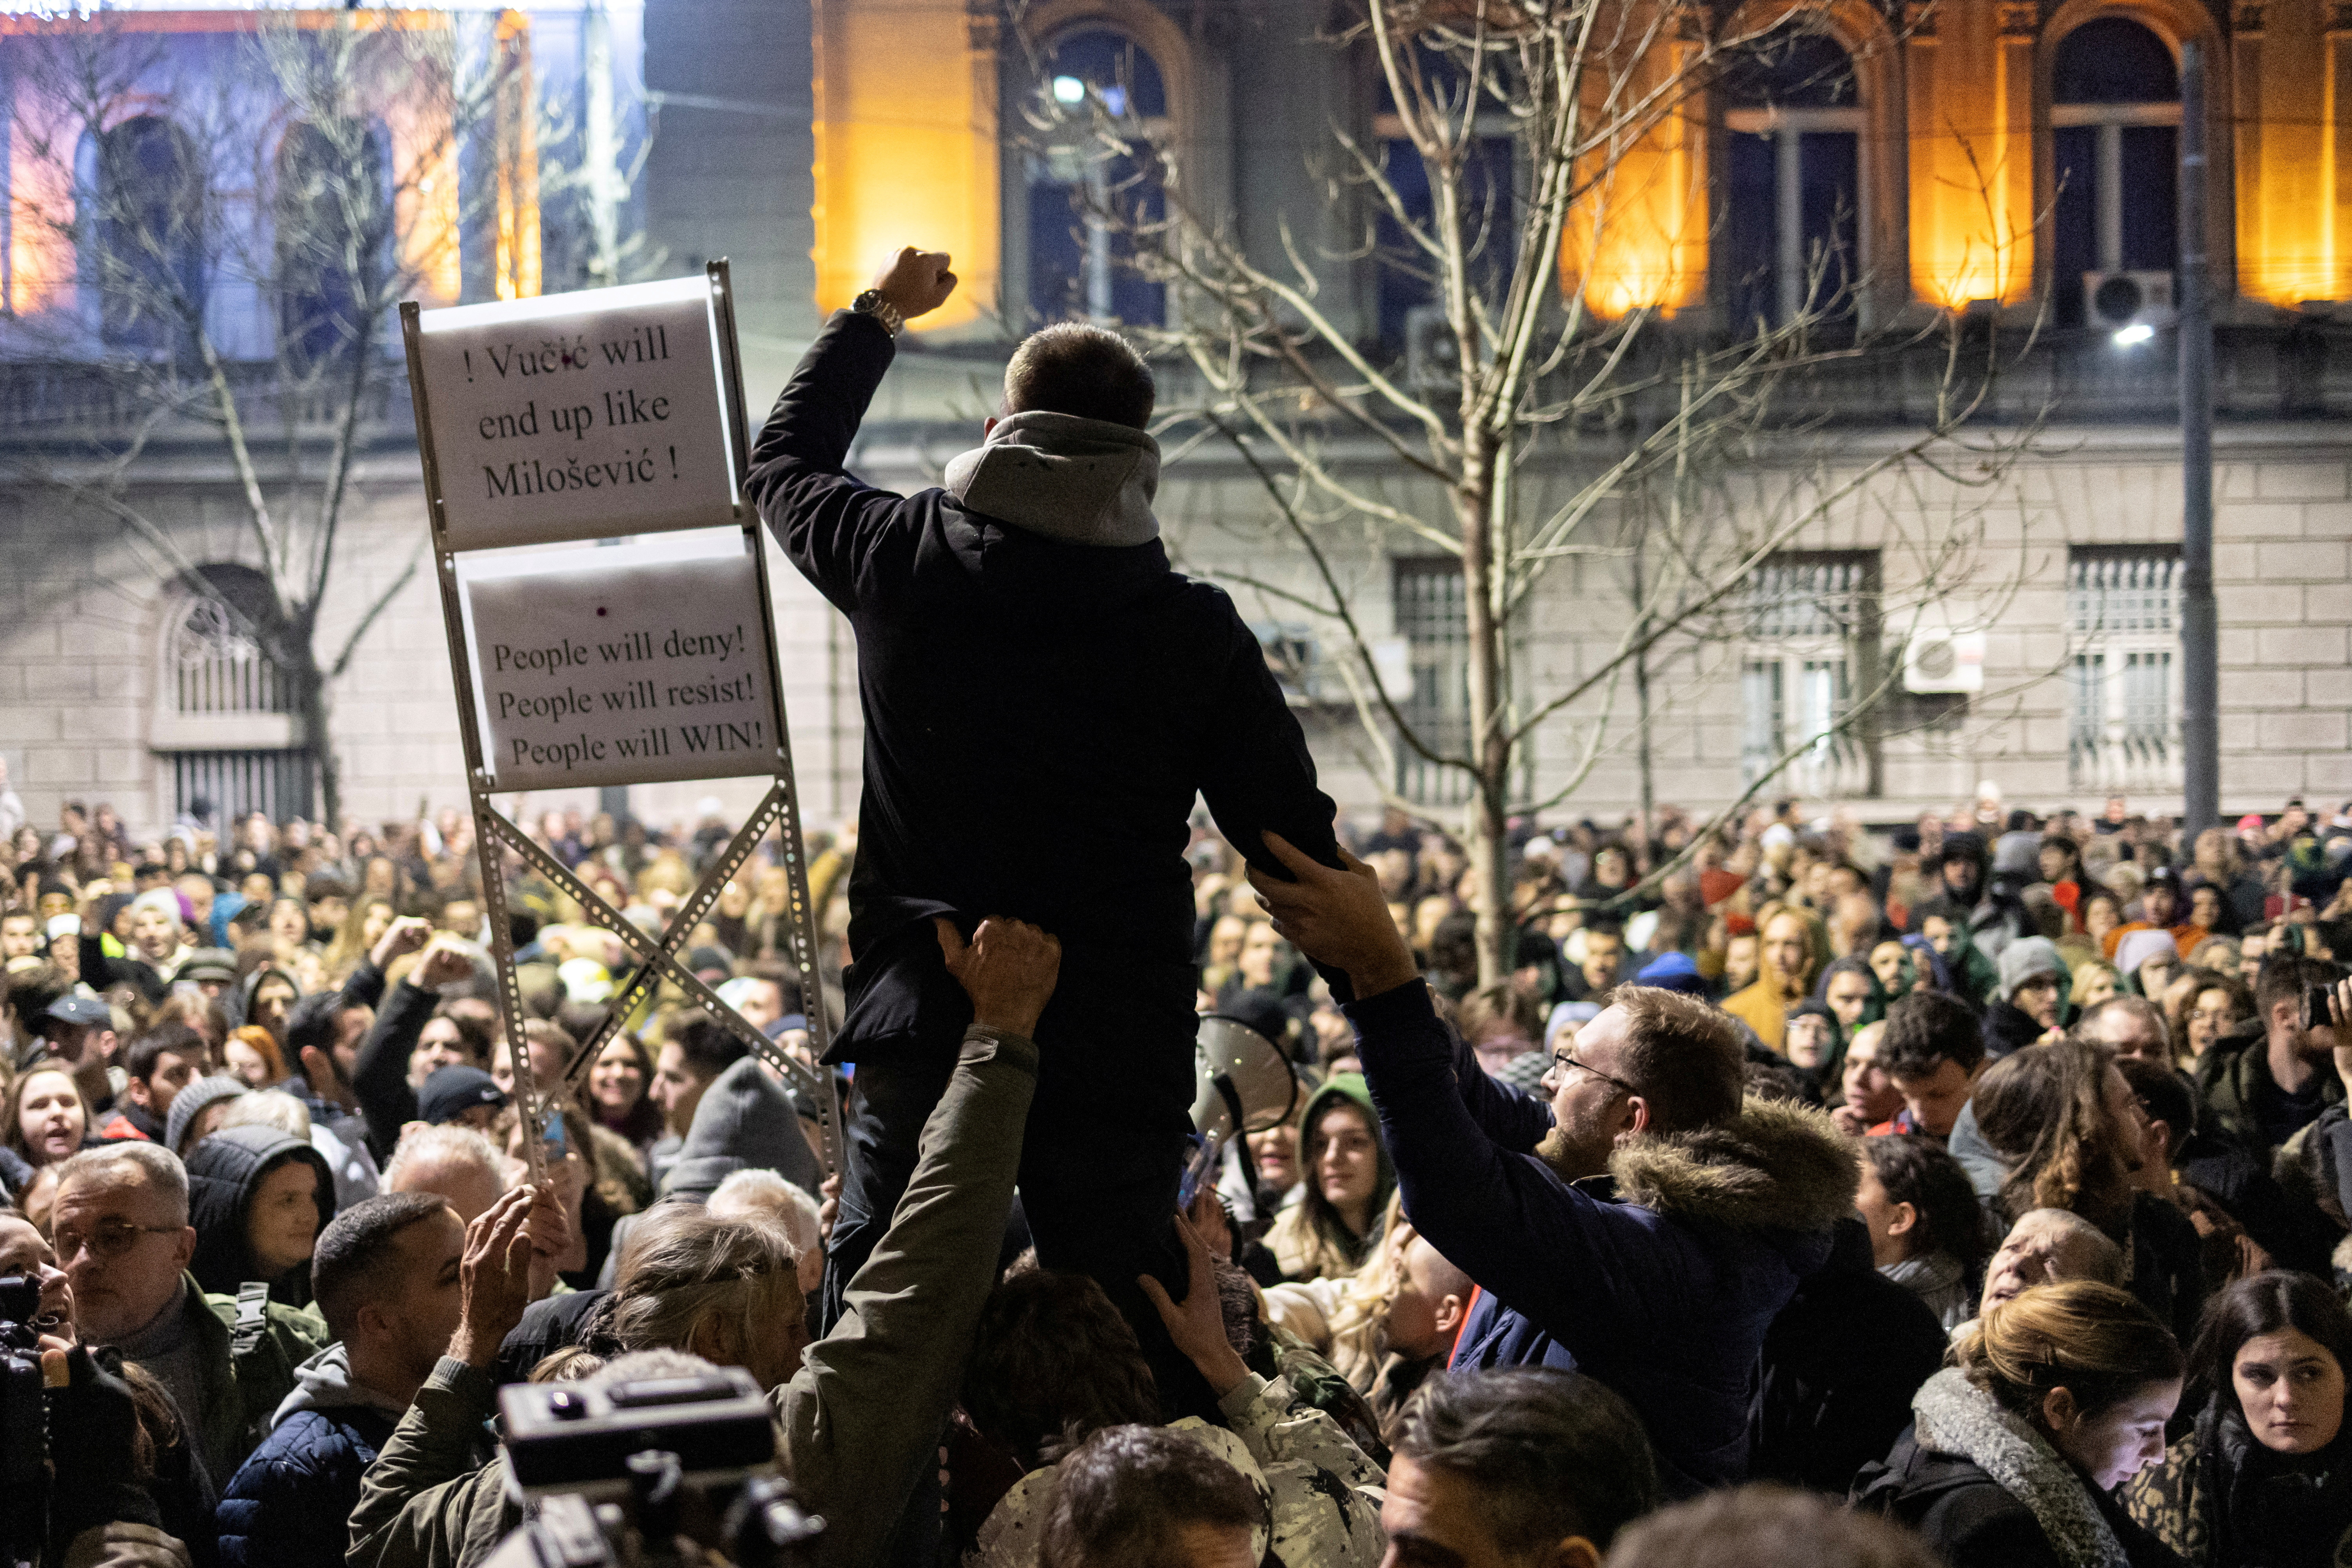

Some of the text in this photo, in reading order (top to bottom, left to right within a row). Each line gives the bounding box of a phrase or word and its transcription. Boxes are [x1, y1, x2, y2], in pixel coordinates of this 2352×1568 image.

[463, 325, 670, 383] ! Vučić will
[479, 389, 670, 441] end up like
[482, 445, 679, 499] Milošević !
[494, 624, 746, 675] People will deny!
[498, 673, 755, 723] People will resist!
[511, 721, 763, 770] People will WIN!
